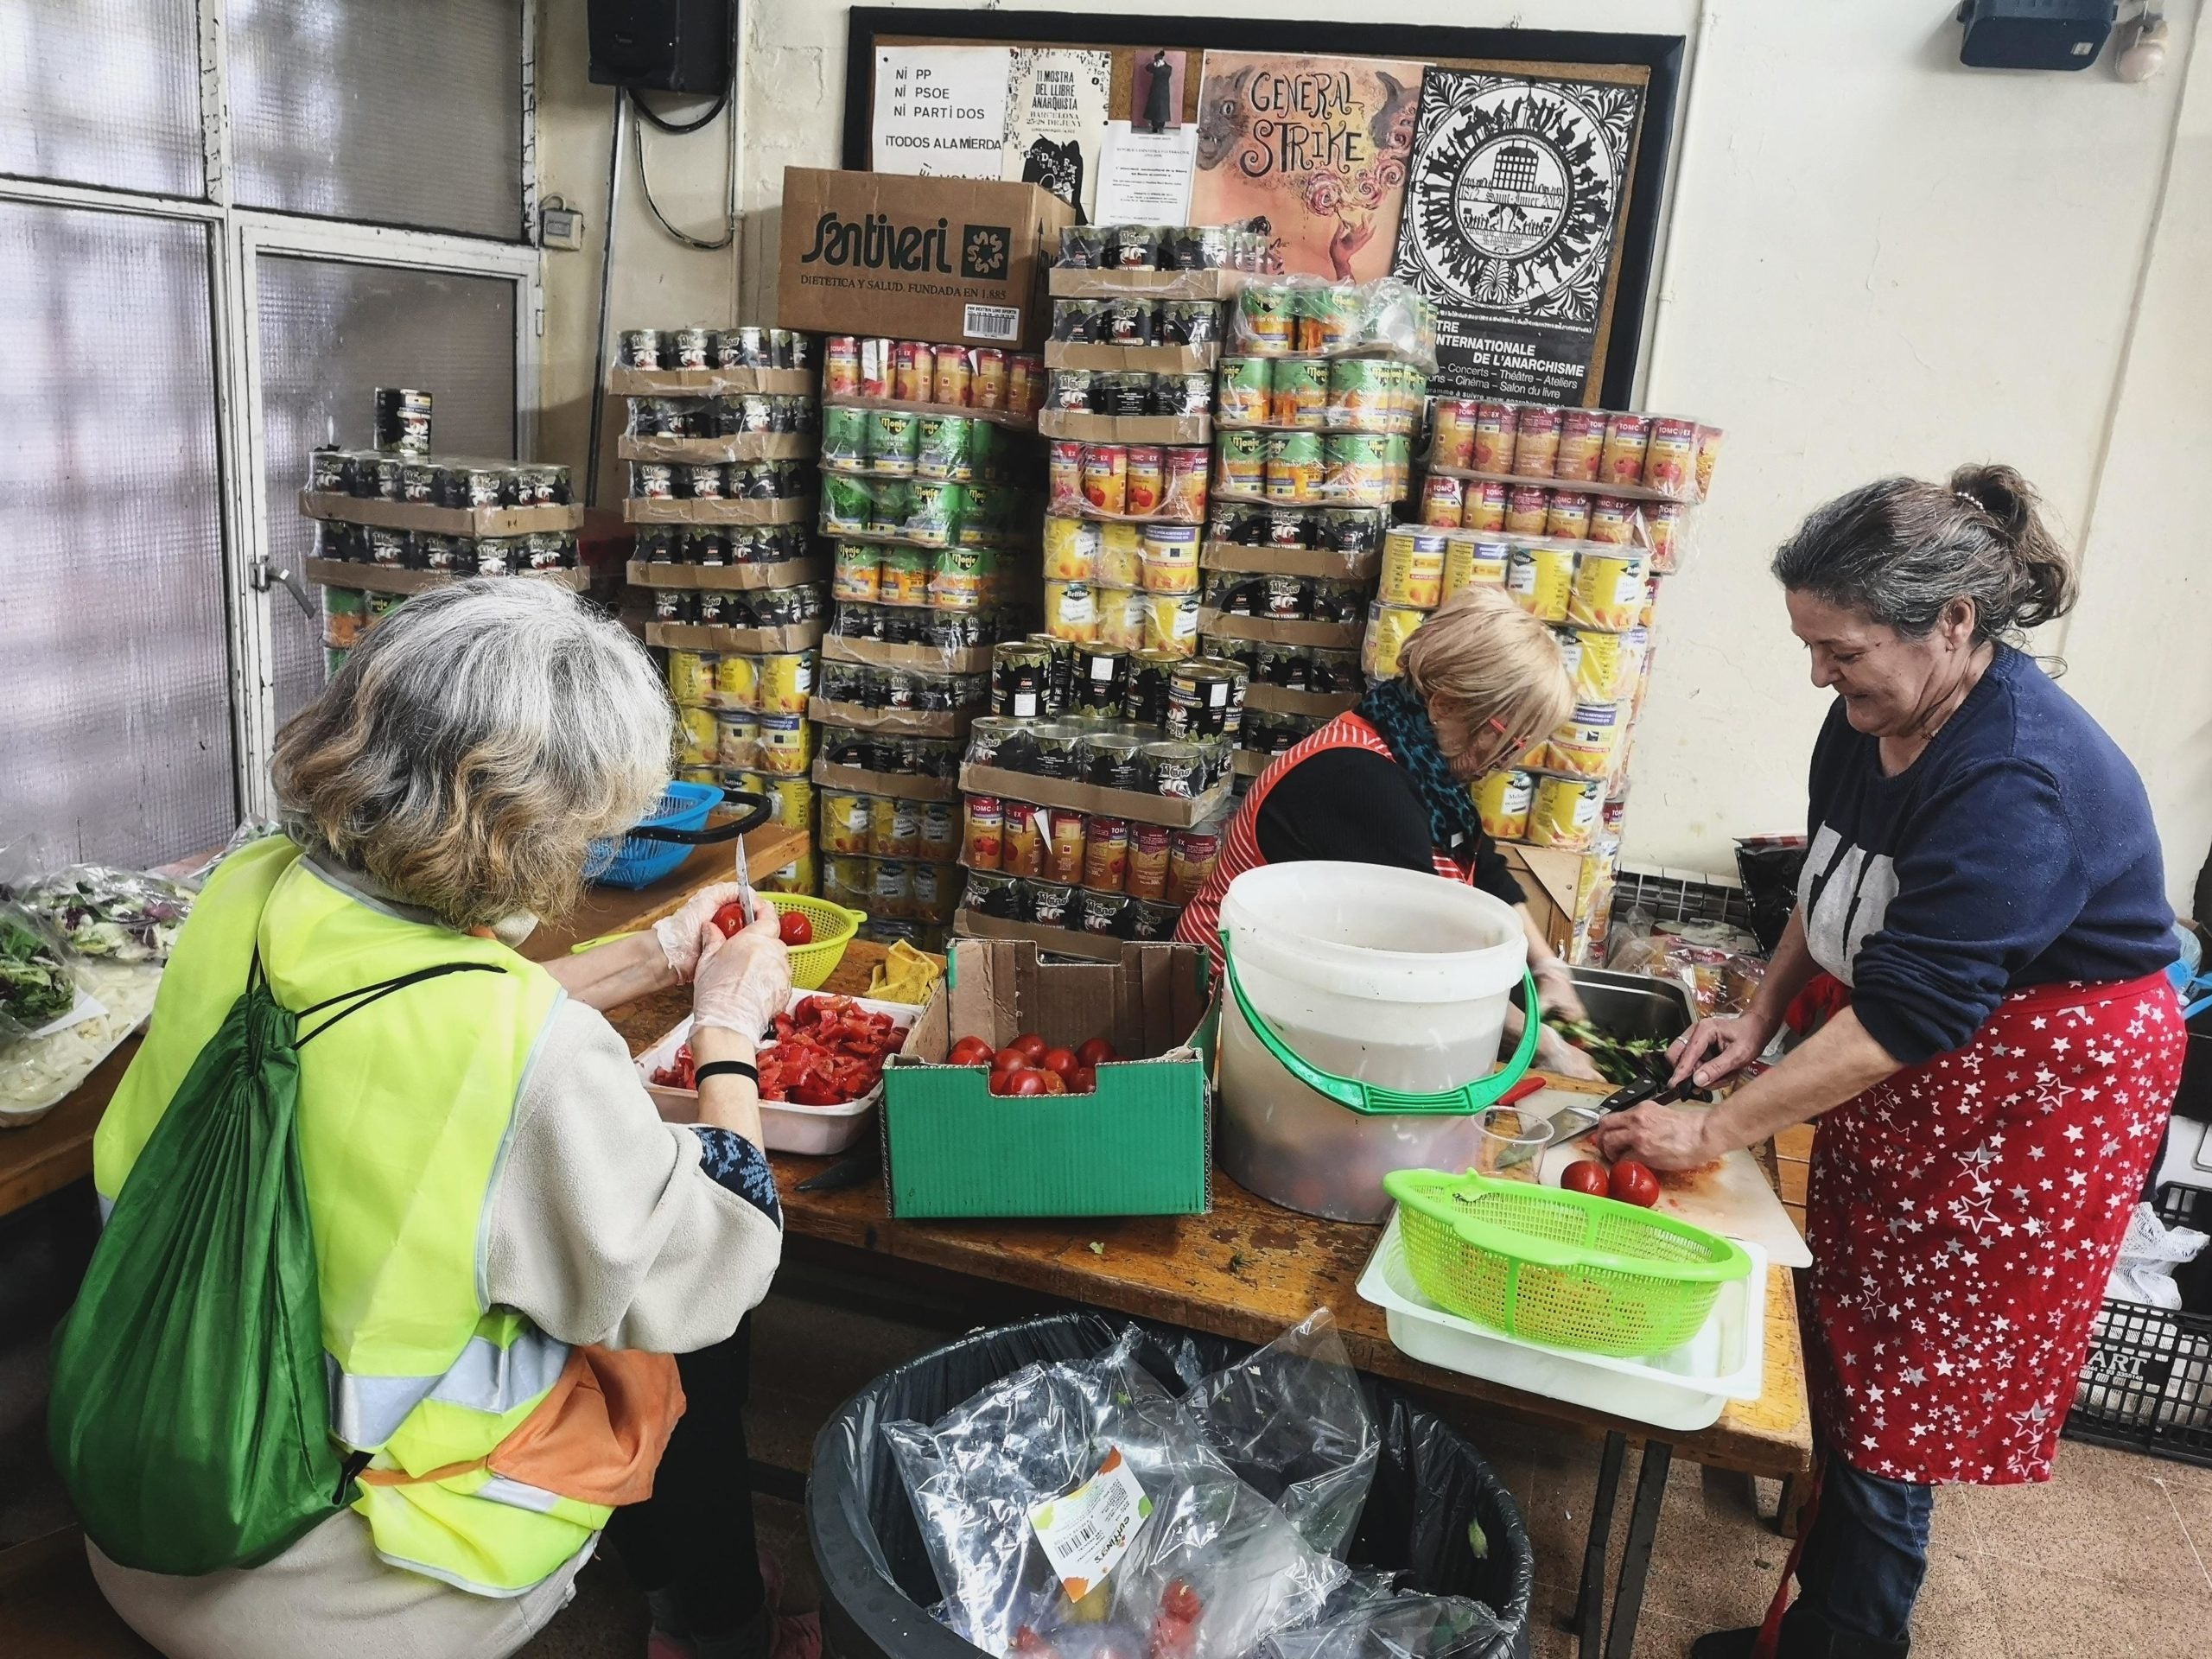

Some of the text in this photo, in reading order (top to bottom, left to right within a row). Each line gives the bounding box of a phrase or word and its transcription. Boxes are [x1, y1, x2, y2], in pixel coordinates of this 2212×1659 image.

[916, 69, 931, 79] PP
[1043, 70, 1074, 84] MOSTRA
[915, 87, 950, 99] PSOE
[1035, 83, 1075, 97] DEL LLIBRE
[1250, 71, 1364, 120] GENERAL
[1031, 96, 1077, 111] ANARQUISTA
[933, 137, 942, 149] A
[943, 138, 958, 149] LA
[1239, 118, 1364, 178] STRIKE
[801, 212, 952, 274] Santiveri
[800, 274, 855, 289] DIETETICA
[856, 278, 866, 289] Y
[907, 283, 962, 297] FUNDADA
[963, 289, 979, 299] EN
[982, 289, 1006, 301] 1.885
[1436, 319, 1460, 334] TRE
[1435, 334, 1536, 357] NTERNATIONALE
[1223, 365, 1240, 381] onje
[1306, 365, 1329, 381] Monj
[1472, 352, 1586, 378] DE L'ANARCHISME
[1447, 363, 1578, 389] Concerts Théâtre Ateliers
[1426, 387, 1454, 397] gramme
[1455, 388, 1461, 397] à
[1461, 391, 1484, 401] suivre
[1427, 374, 1560, 400] ons Cinéma Salon du livre
[881, 417, 907, 433] Monje
[952, 553, 976, 568] Monje
[2087, 1350, 2148, 1376] ART
